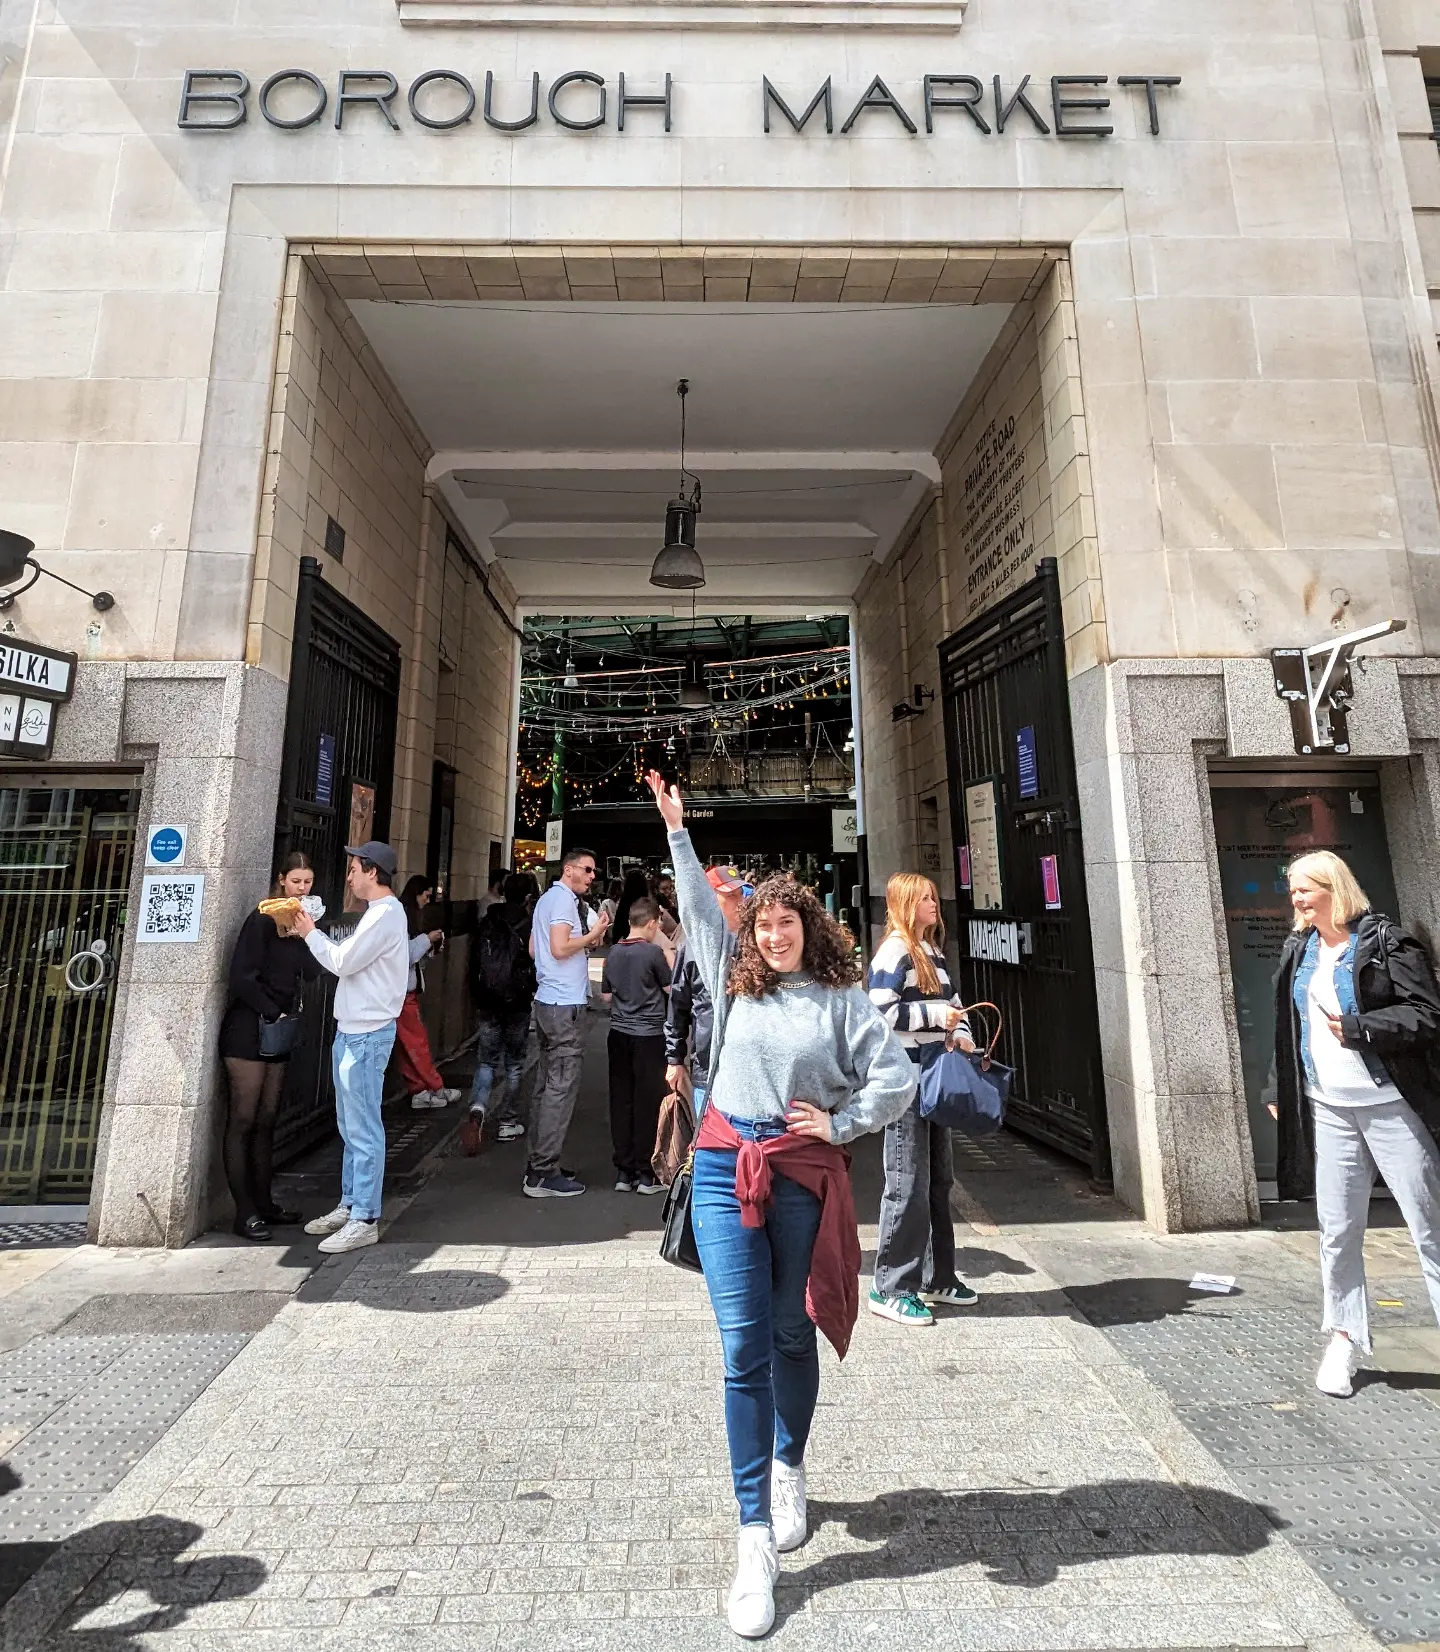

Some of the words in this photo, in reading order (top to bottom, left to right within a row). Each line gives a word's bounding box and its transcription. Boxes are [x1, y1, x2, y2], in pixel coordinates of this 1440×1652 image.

[177, 69, 671, 132] BOROUGH
[762, 73, 1182, 135] MARKET
[965, 449, 990, 495] PRIVATE
[992, 415, 1015, 459] ROAD
[975, 418, 996, 455] NOTICE
[976, 466, 998, 502] PROPERTY
[999, 458, 1005, 473] OF
[1006, 443, 1016, 462] THE
[981, 484, 998, 514] MARKET
[999, 451, 1025, 489] TRUSTEES
[1004, 474, 1025, 509] EXCEPT
[975, 530, 994, 560] MARKET
[995, 499, 1020, 537] BUSINESS
[967, 543, 1003, 595] ENTRANCE
[1003, 517, 1026, 557] ONLY
[995, 566, 1010, 589] MILES
[1010, 556, 1020, 575] PER
[1020, 543, 1034, 564] HOUR
[0, 646, 49, 685] SILKA
[20, 716, 48, 729] Silka
[692, 809, 714, 818] Garden
